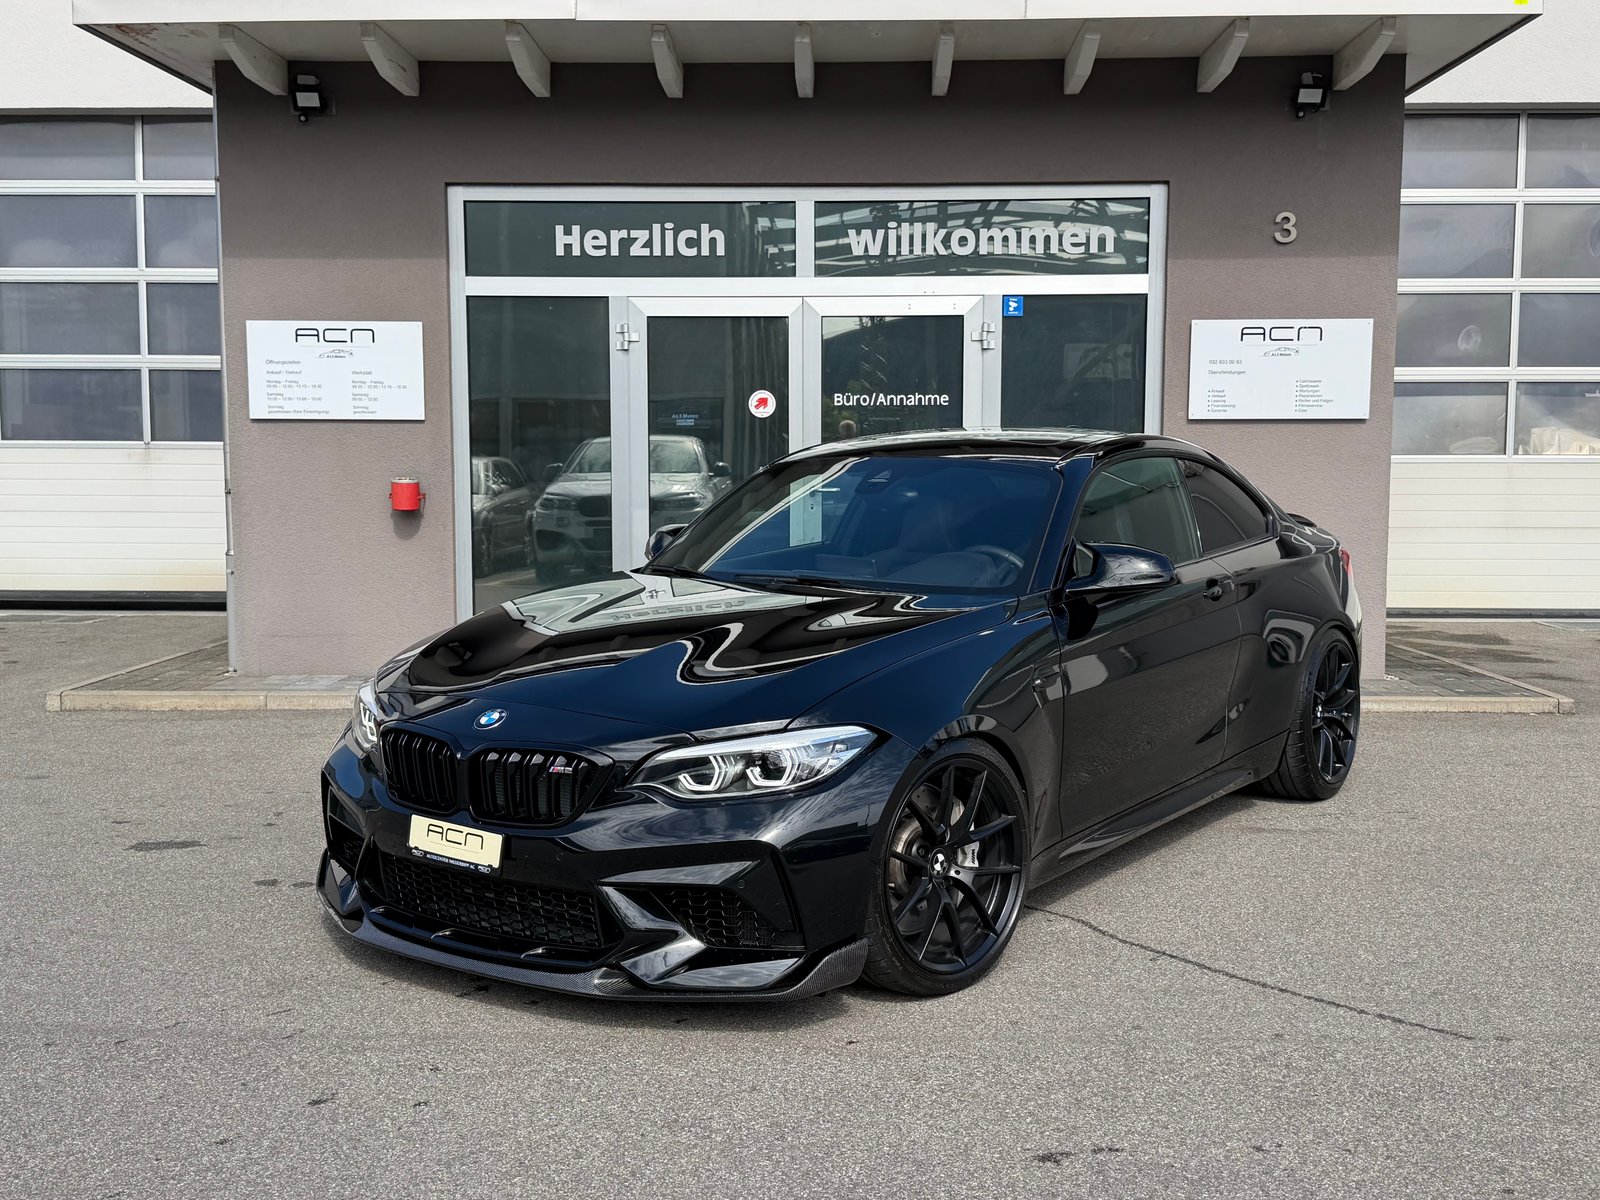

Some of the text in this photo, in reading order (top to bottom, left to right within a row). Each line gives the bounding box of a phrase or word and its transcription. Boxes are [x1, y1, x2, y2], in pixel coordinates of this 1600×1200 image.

[1274, 211, 1297, 243] 3
[555, 221, 1115, 257] Herzlich willkommen
[295, 328, 375, 343] ACN
[1240, 326, 1322, 341] ACN
[833, 392, 949, 406] Büro/Annahme
[427, 823, 484, 850] ACN
